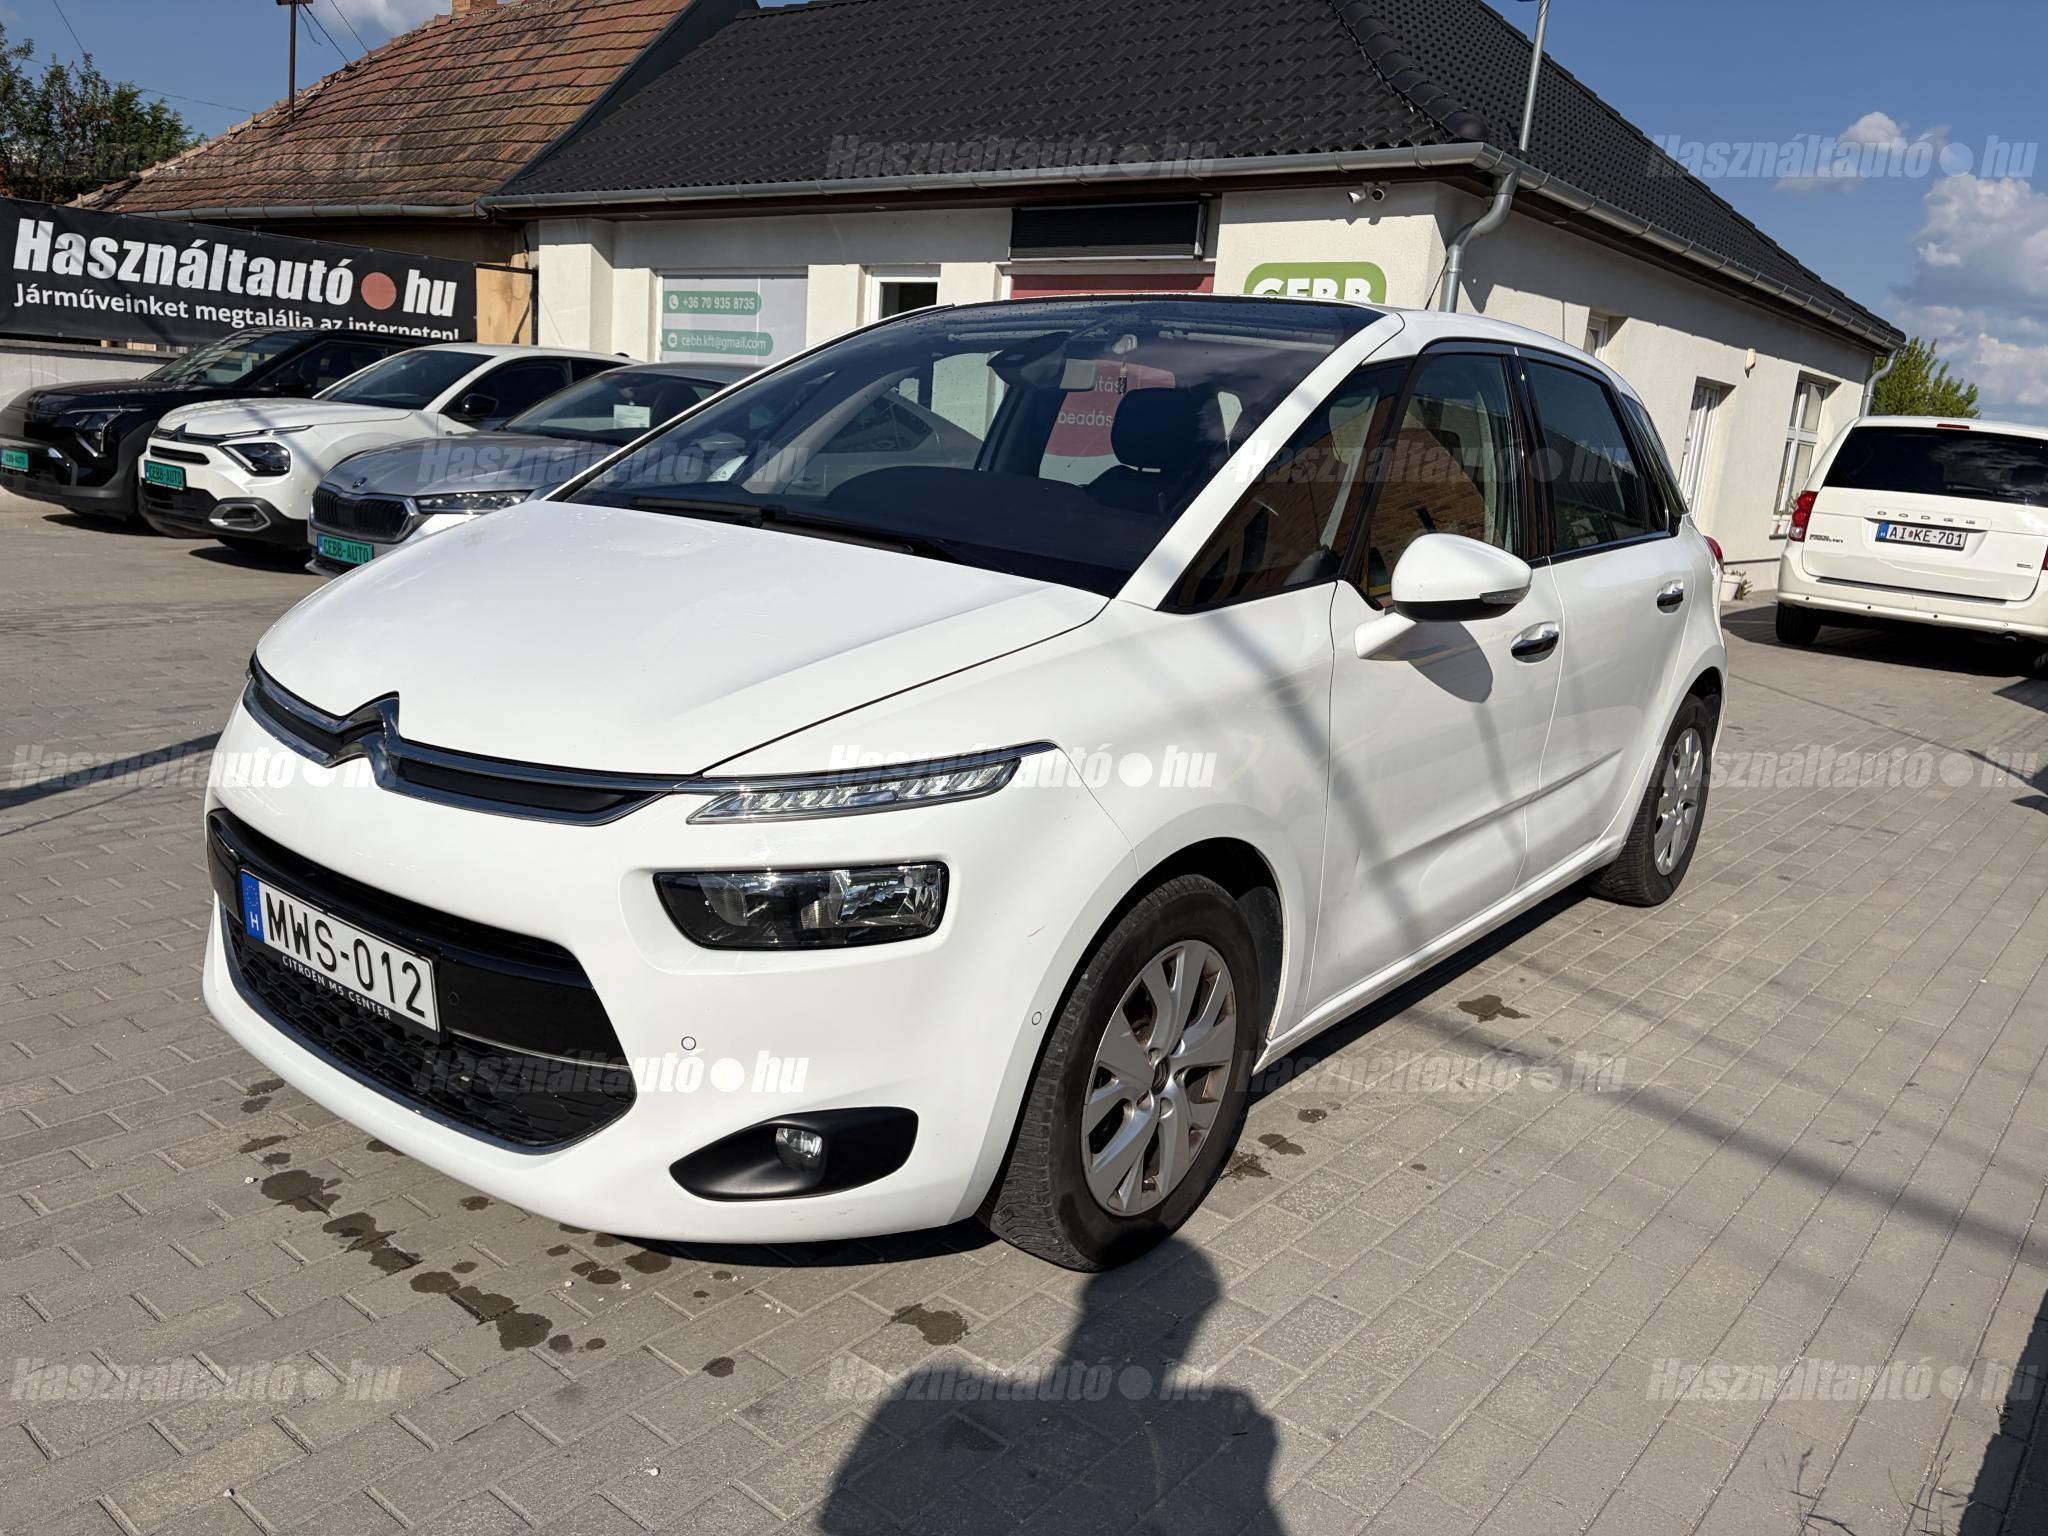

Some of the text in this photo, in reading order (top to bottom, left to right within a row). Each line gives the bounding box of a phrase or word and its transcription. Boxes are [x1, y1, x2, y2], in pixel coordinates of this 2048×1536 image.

[14, 283, 188, 319] Járműveinket
[320, 319, 342, 330] az
[683, 297, 755, 310] +36 70 935 8735
[681, 334, 767, 351] cebb.kft@gmail.com
[324, 539, 369, 562] CEBB-AUTO
[266, 892, 425, 1018] MWS-012
[348, 991, 390, 1020] CENTER
